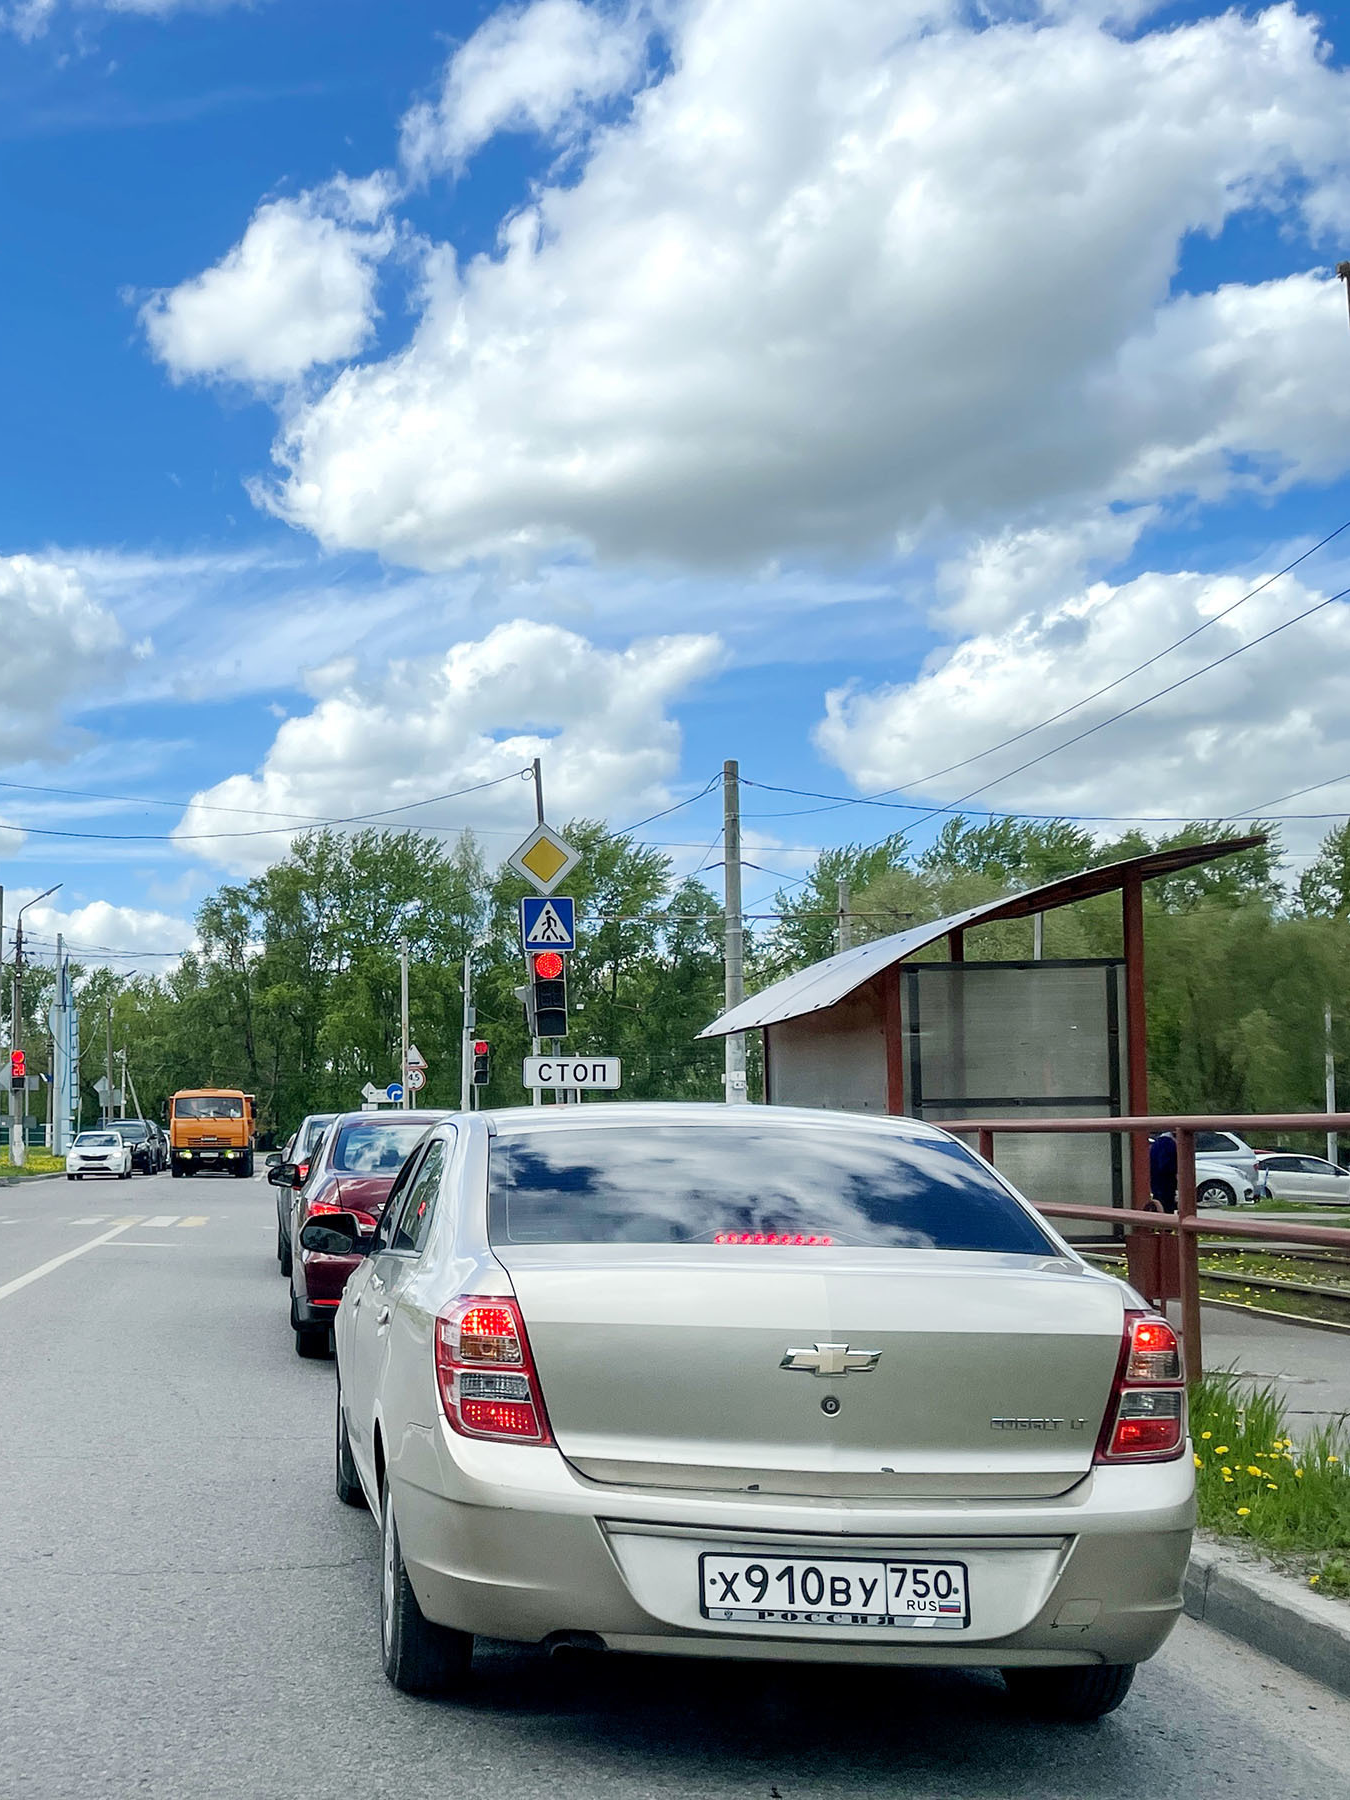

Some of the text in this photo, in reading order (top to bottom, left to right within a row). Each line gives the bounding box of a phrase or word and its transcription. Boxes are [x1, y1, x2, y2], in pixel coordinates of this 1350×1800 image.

[538, 1063, 606, 1082] СТОП
[890, 1568, 953, 1599] 750
[907, 1600, 937, 1612] RUS
